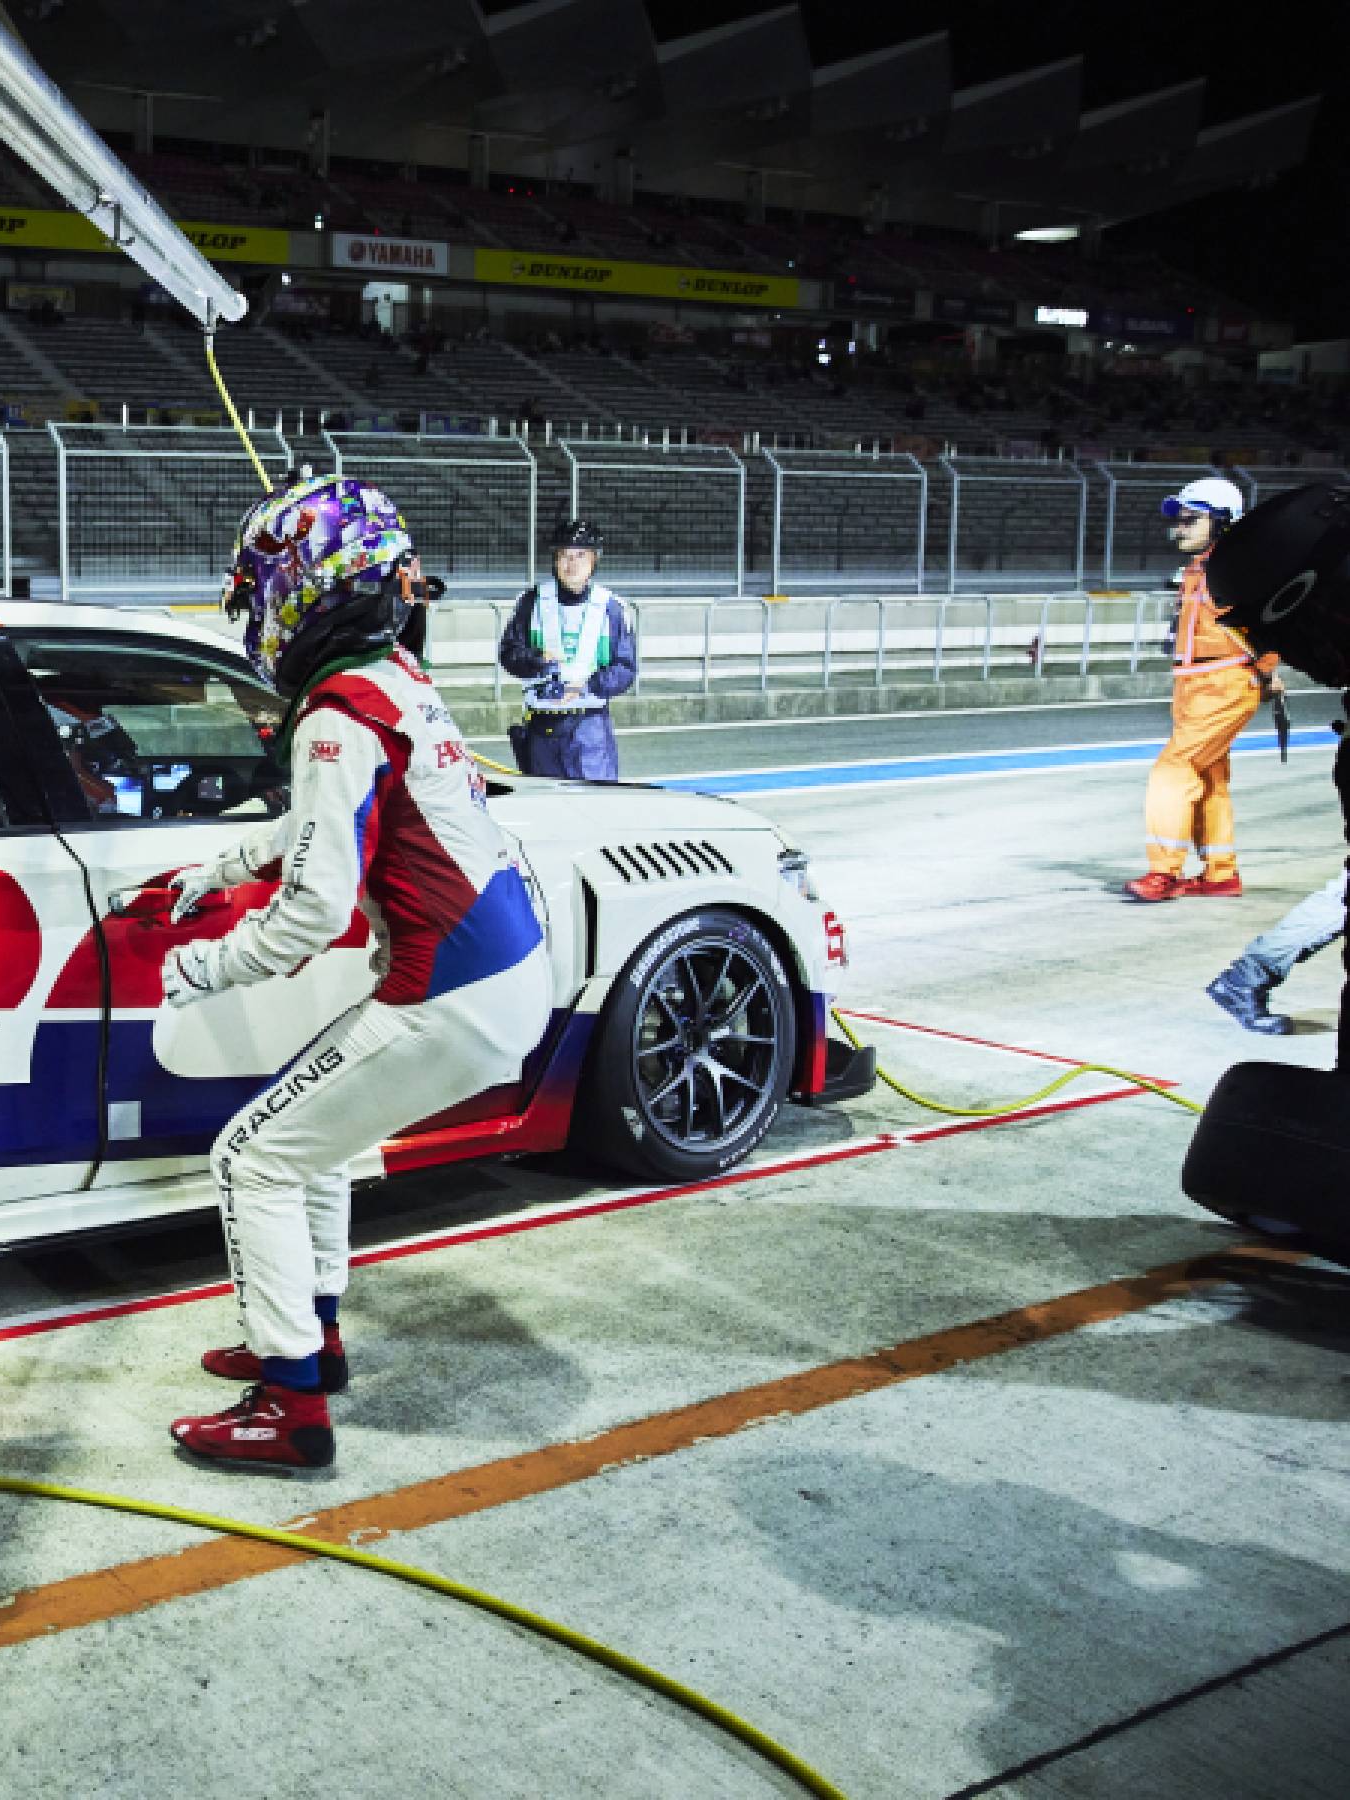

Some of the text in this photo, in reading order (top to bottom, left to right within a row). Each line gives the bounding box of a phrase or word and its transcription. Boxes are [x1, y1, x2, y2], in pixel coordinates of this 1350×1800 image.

[186, 231, 247, 250] NLOP
[368, 242, 436, 268] YAMAHA
[529, 261, 612, 282] DUNLOP
[694, 277, 769, 298] DUNLOP
[226, 1046, 346, 1154] RACING
